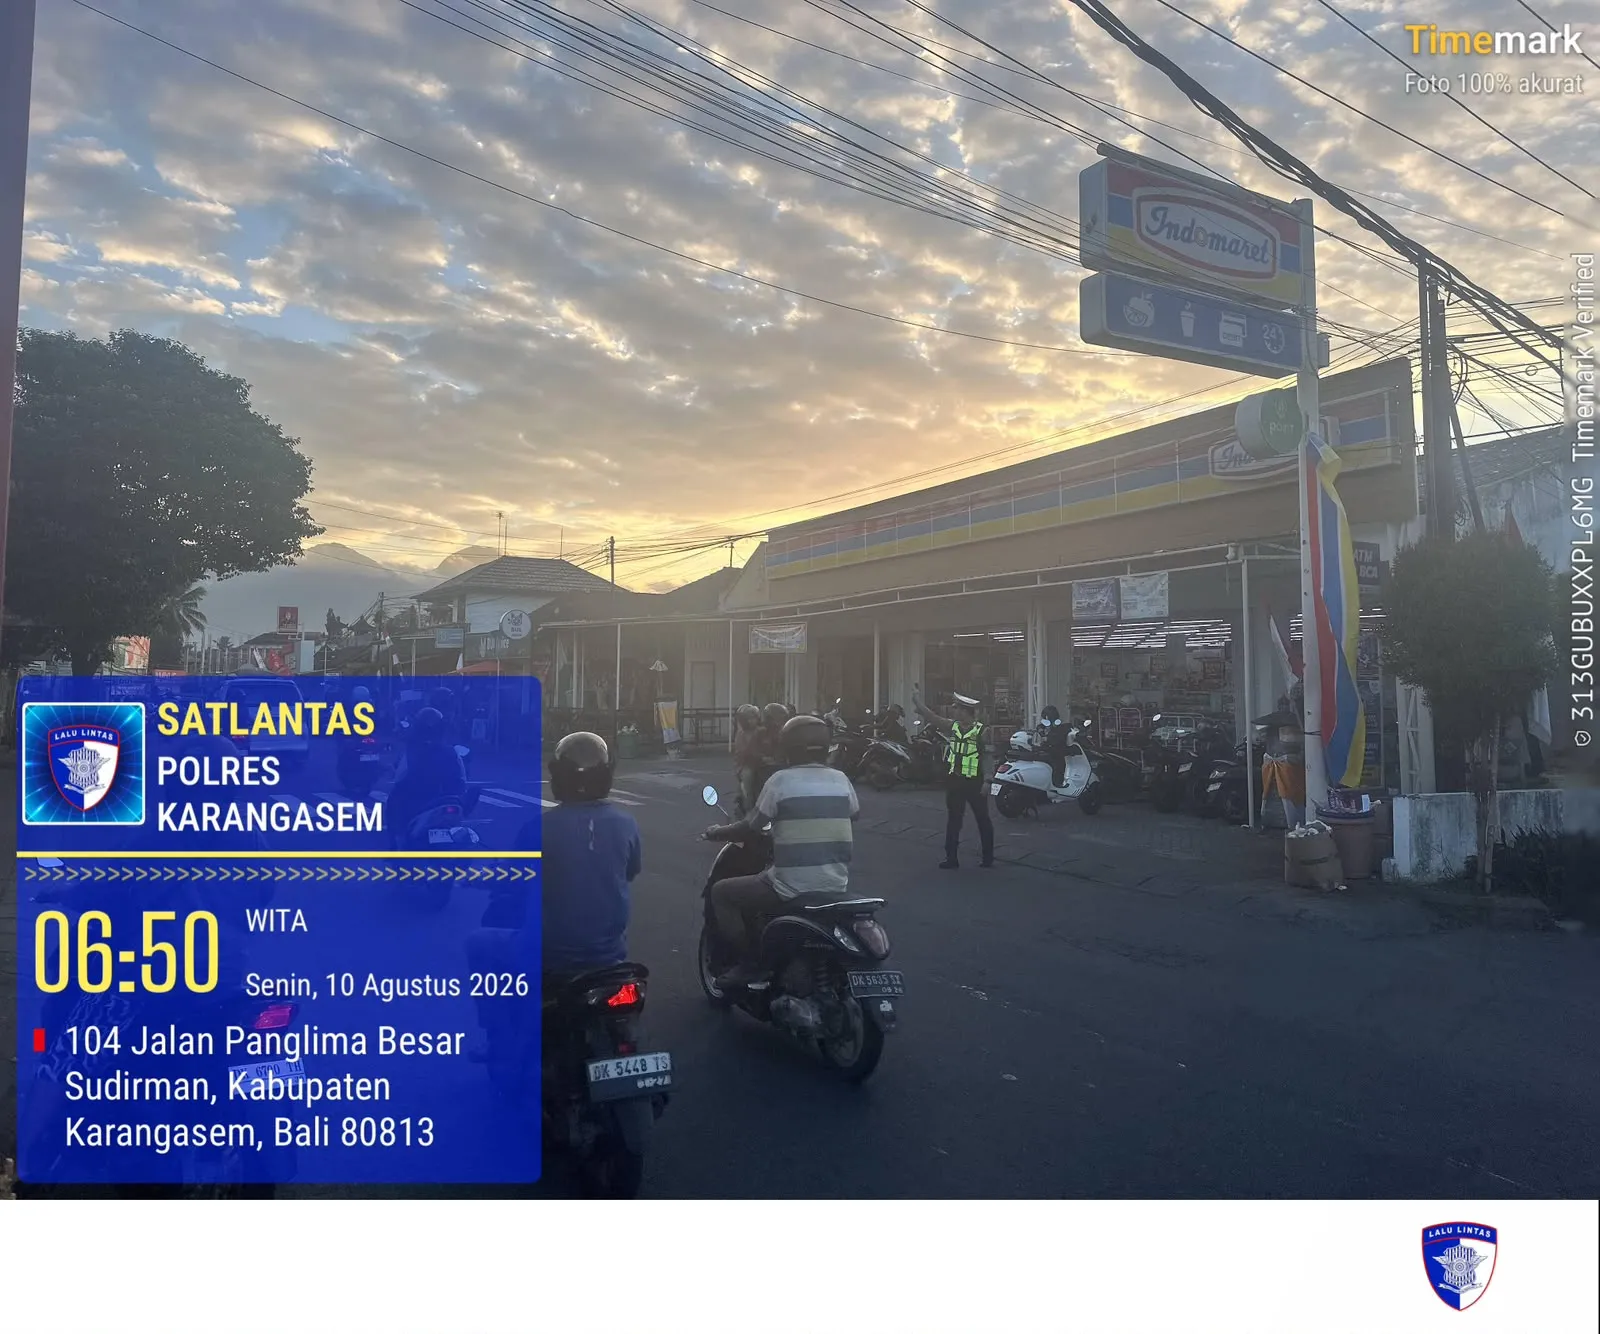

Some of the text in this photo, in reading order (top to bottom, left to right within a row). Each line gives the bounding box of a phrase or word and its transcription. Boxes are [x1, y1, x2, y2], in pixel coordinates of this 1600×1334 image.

[1145, 206, 1270, 265] Indomaret
[1353, 549, 1373, 563] ATM
[1359, 565, 1379, 579] BCA
[615, 1058, 648, 1076] 5448
